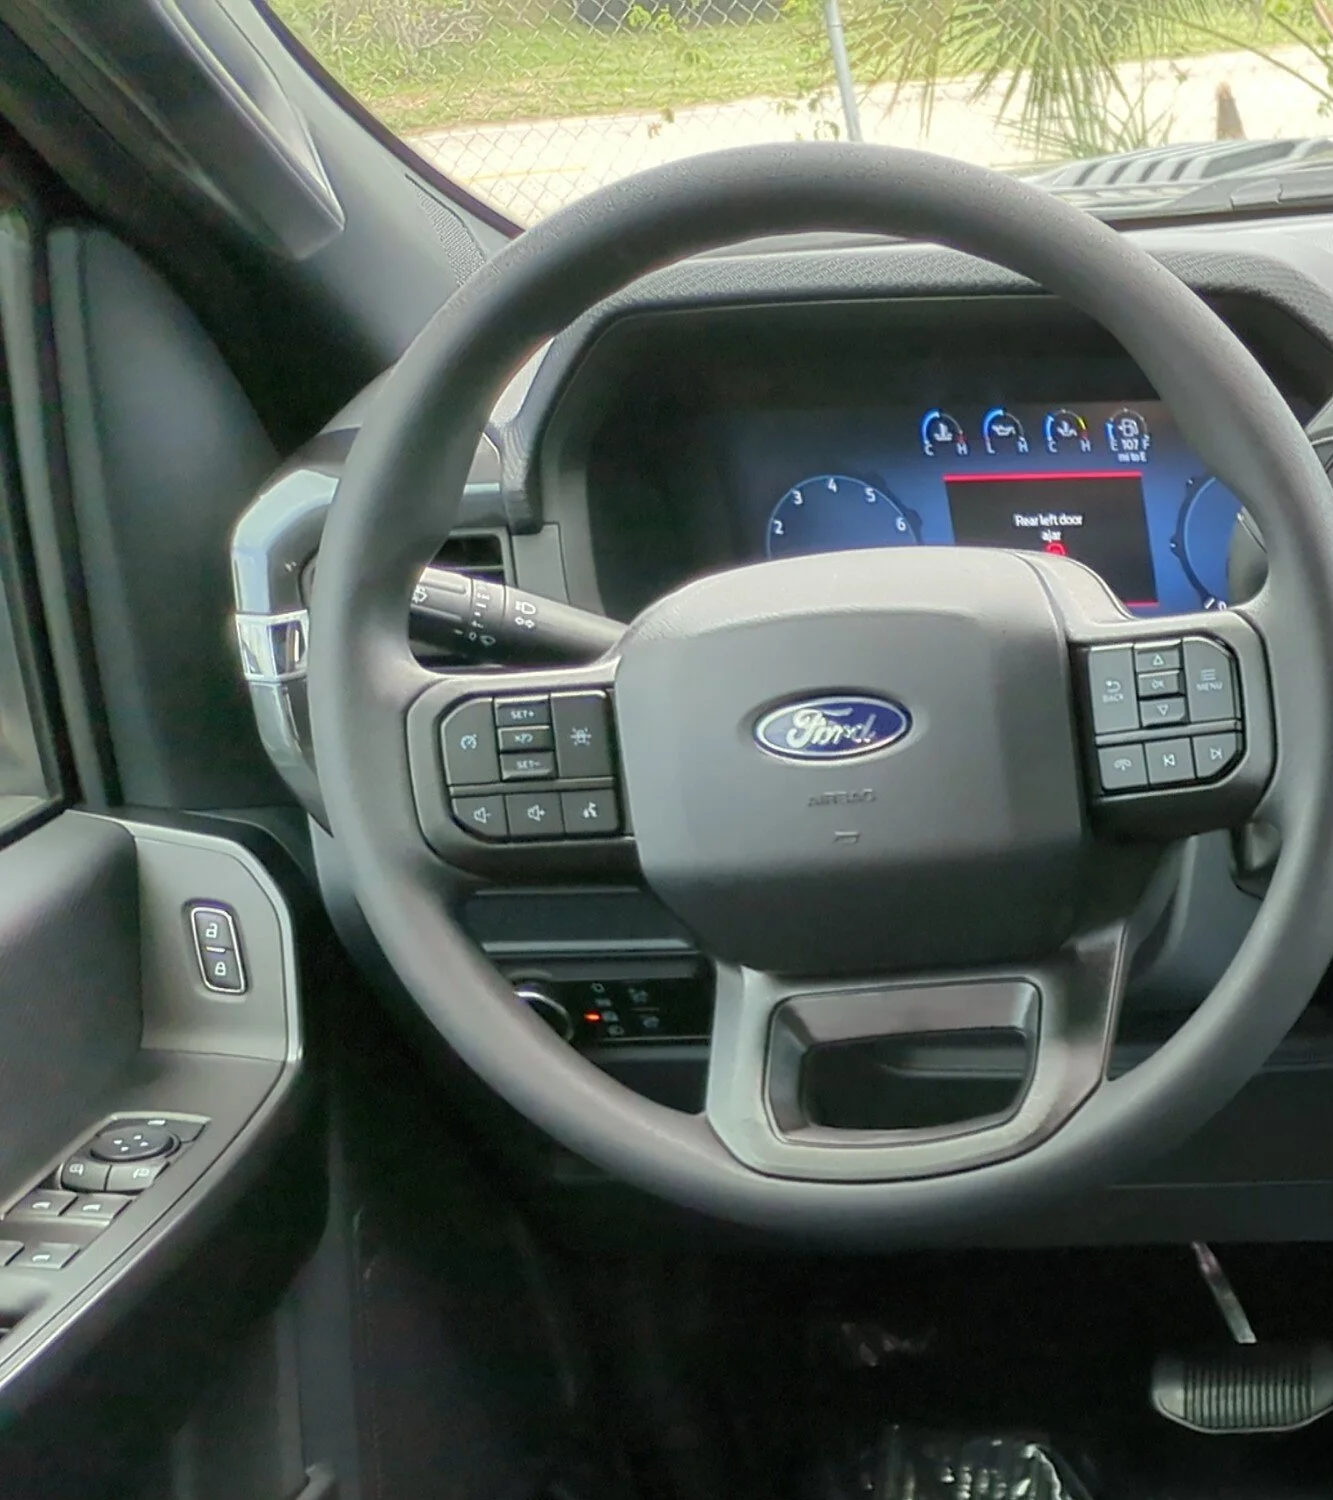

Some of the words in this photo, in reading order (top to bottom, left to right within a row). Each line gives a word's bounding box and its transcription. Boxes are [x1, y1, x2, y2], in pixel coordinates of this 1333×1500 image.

[828, 478, 837, 492] 4
[792, 490, 803, 505] 3
[864, 487, 876, 502] 5
[896, 517, 906, 531] 6
[1014, 513, 1038, 526] Rear
[1039, 513, 1058, 526] left
[1059, 513, 1083, 525] door
[774, 520, 784, 534] 2
[1042, 529, 1061, 542] ajar
[1196, 682, 1223, 691] MENU
[786, 708, 877, 749] Ford
